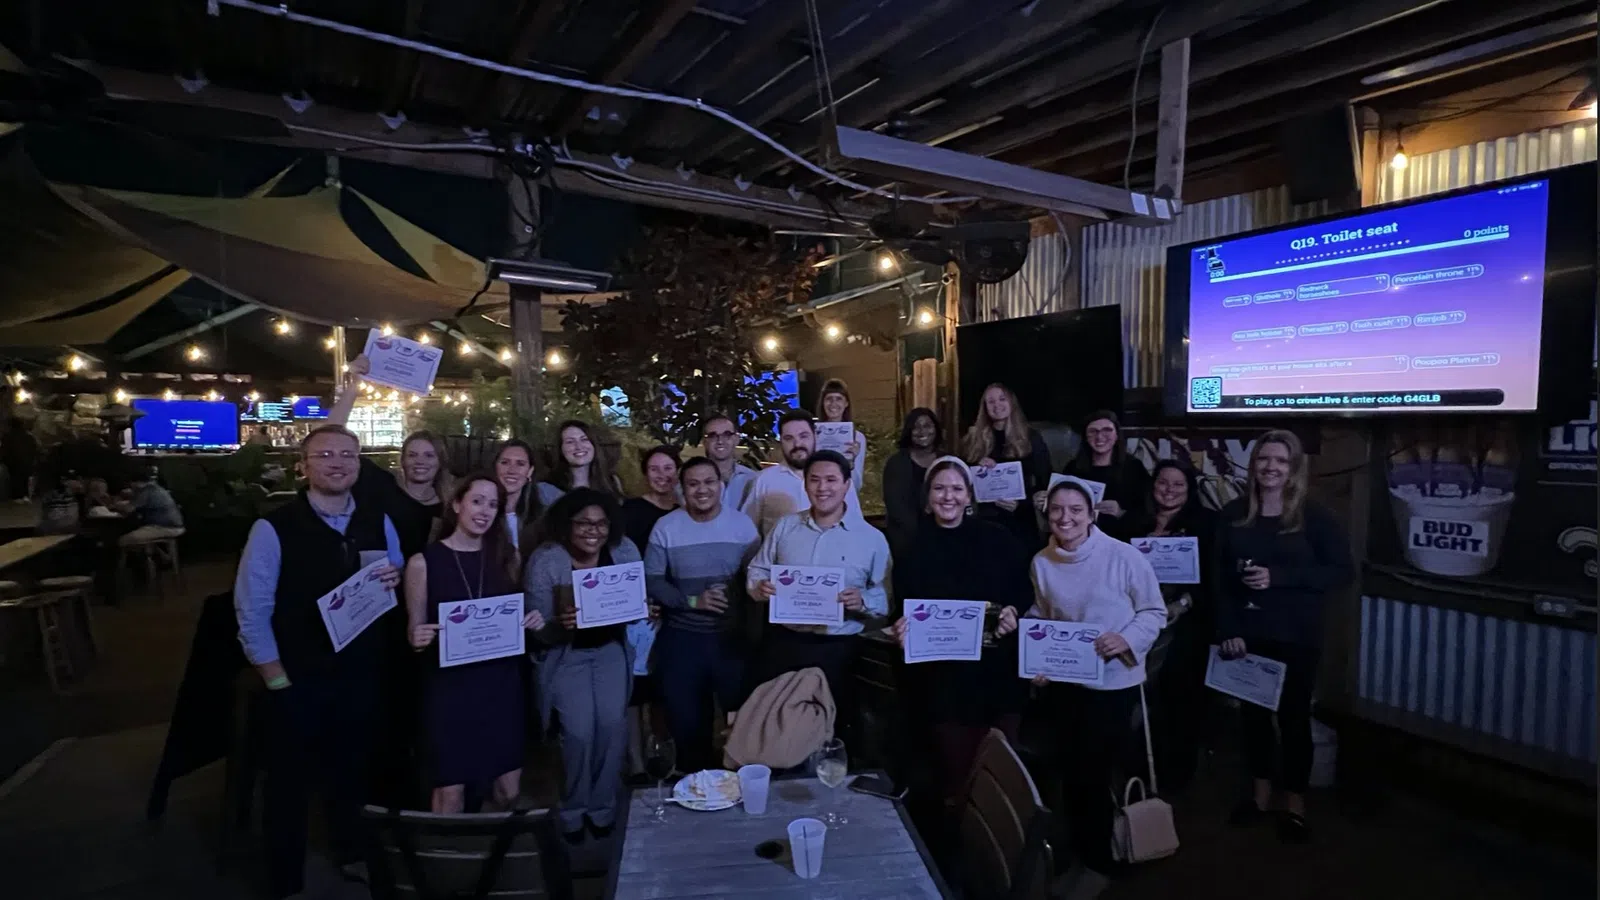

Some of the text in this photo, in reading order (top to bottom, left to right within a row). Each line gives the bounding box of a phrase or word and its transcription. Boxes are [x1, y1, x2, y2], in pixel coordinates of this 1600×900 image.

[1290, 222, 1399, 250] Q19. Toilet seat
[1464, 225, 1509, 239] 0 points
[1394, 269, 1464, 283] Porcelain throne
[1417, 315, 1447, 324] Rimjob
[1415, 358, 1449, 366] Poopoo
[1255, 398, 1273, 406] play,
[1377, 395, 1402, 403] code
[1423, 520, 1472, 537] BUD
[1413, 533, 1483, 552] LIGHT
